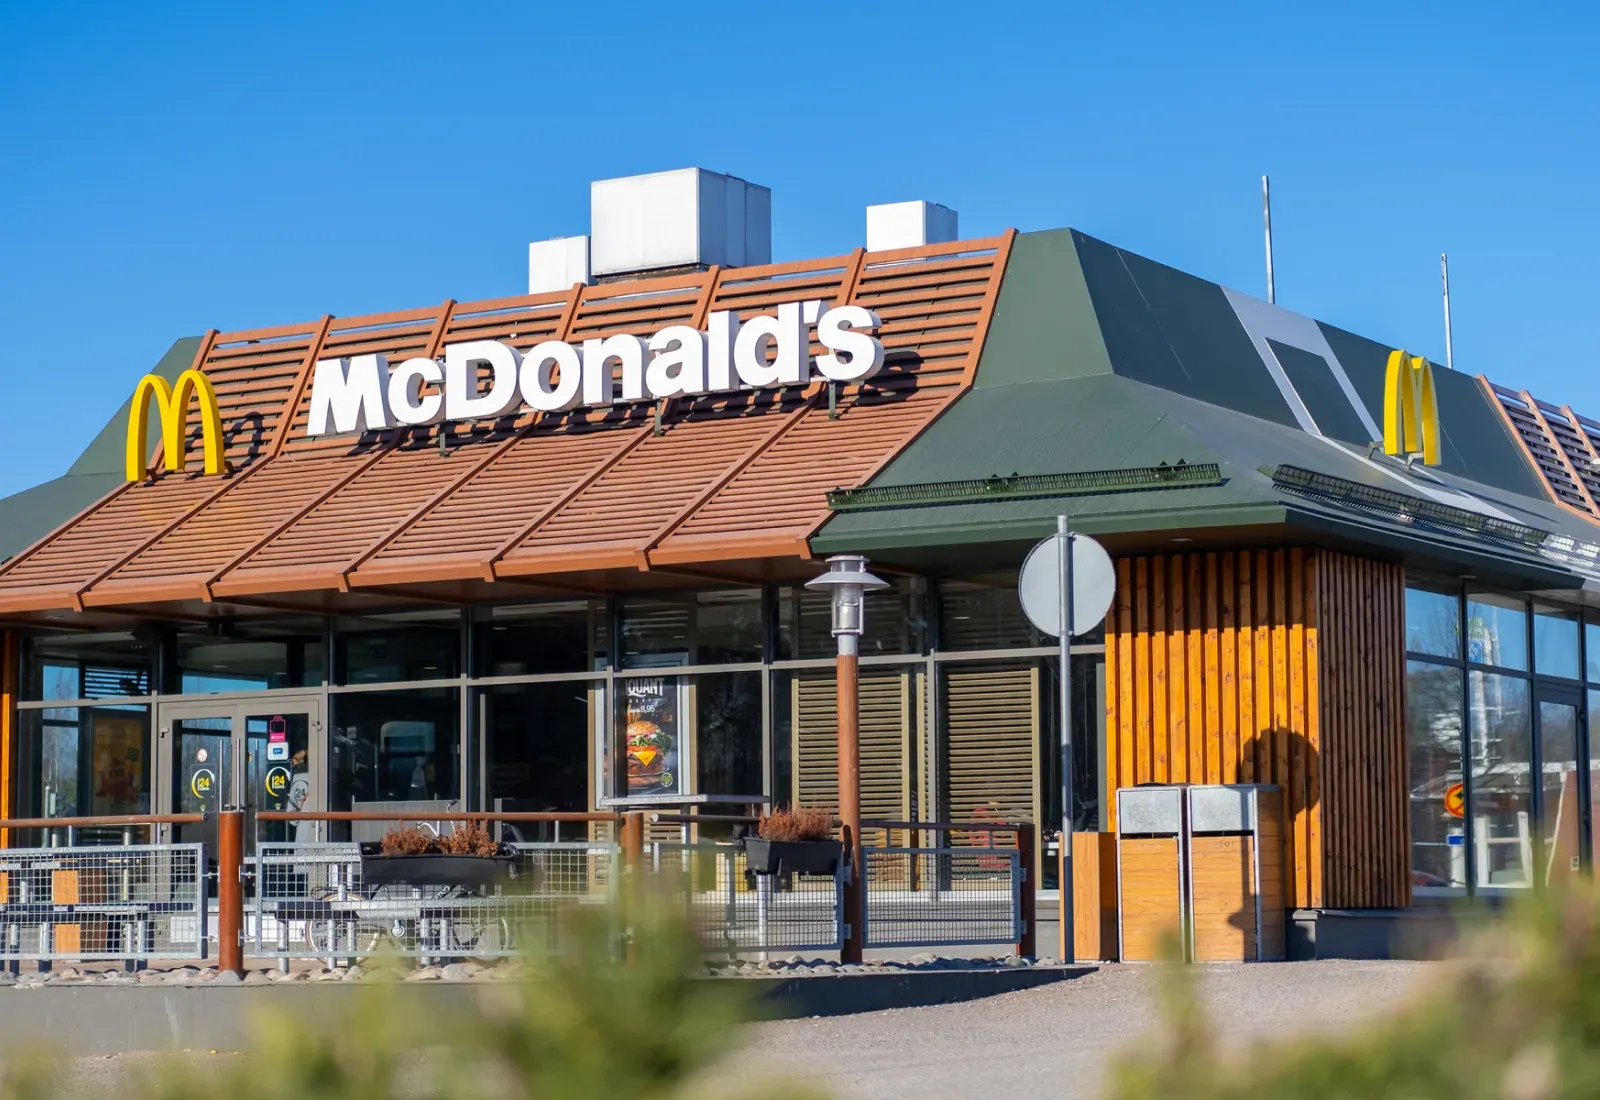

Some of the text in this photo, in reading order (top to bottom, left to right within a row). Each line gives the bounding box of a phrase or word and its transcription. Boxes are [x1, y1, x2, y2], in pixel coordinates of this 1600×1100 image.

[306, 300, 884, 435] McDonald's
[200, 777, 210, 787] 24
[274, 775, 285, 786] 24
